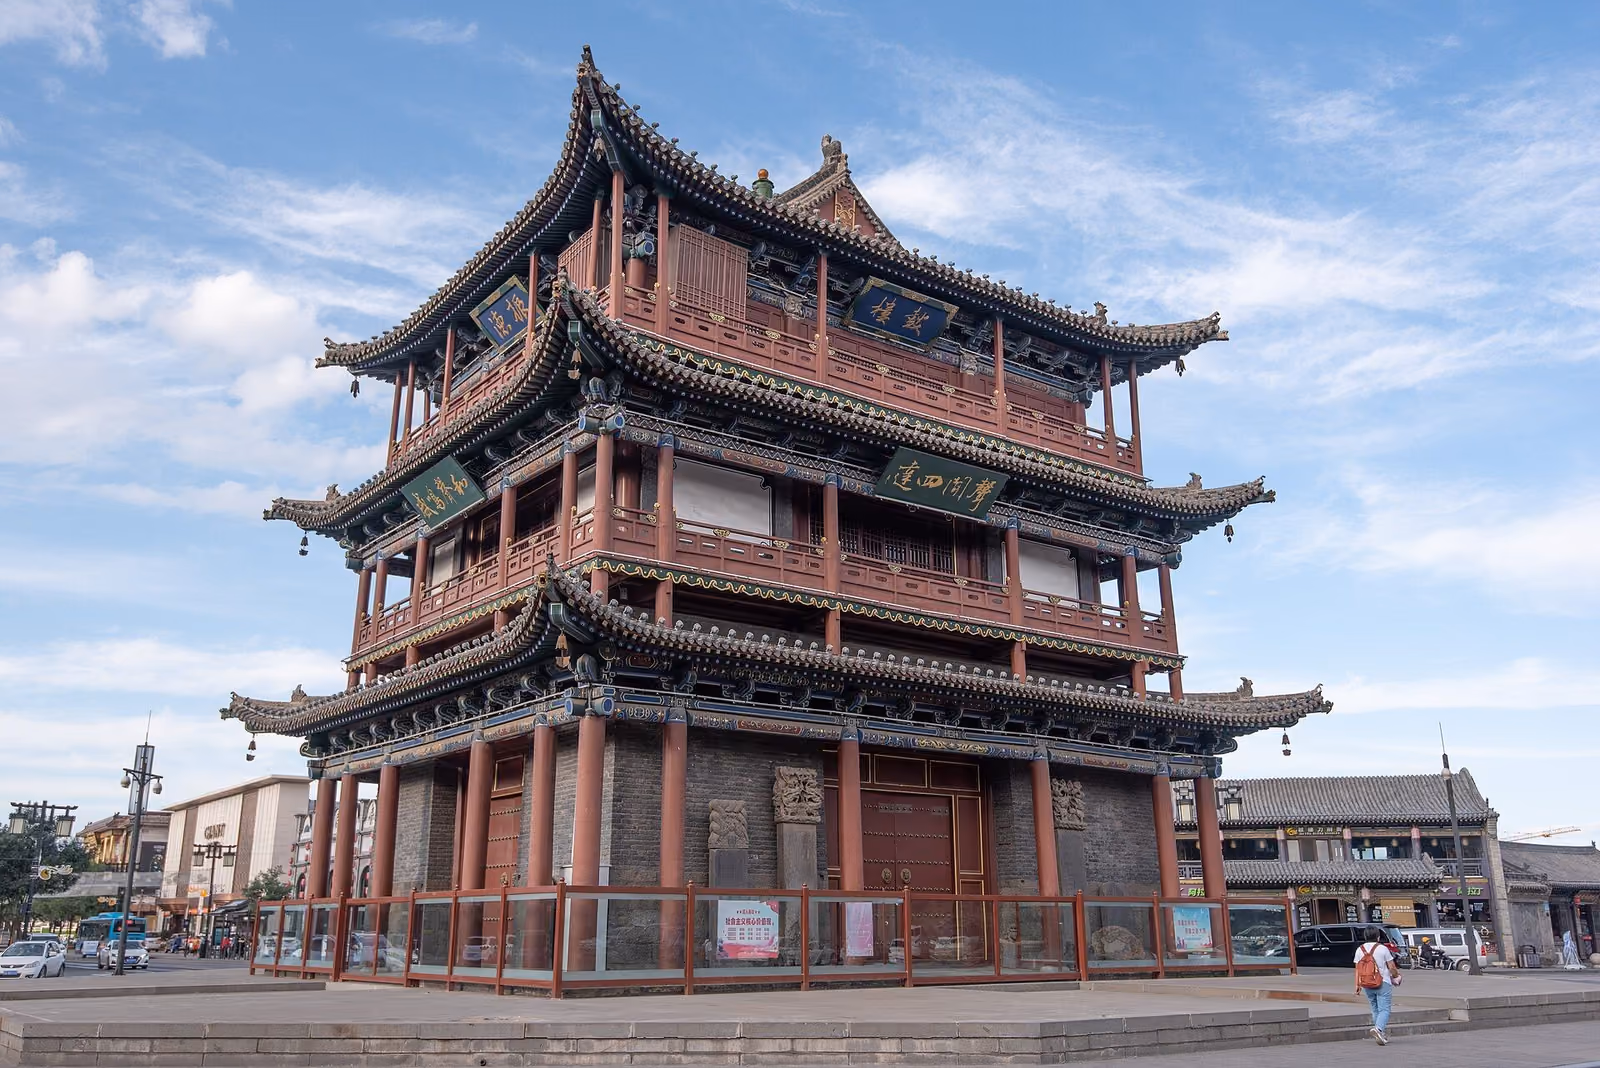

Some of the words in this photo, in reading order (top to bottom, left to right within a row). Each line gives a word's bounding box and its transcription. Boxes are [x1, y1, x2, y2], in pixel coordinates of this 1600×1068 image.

[725, 917, 772, 926] 社会主义核心价值观
